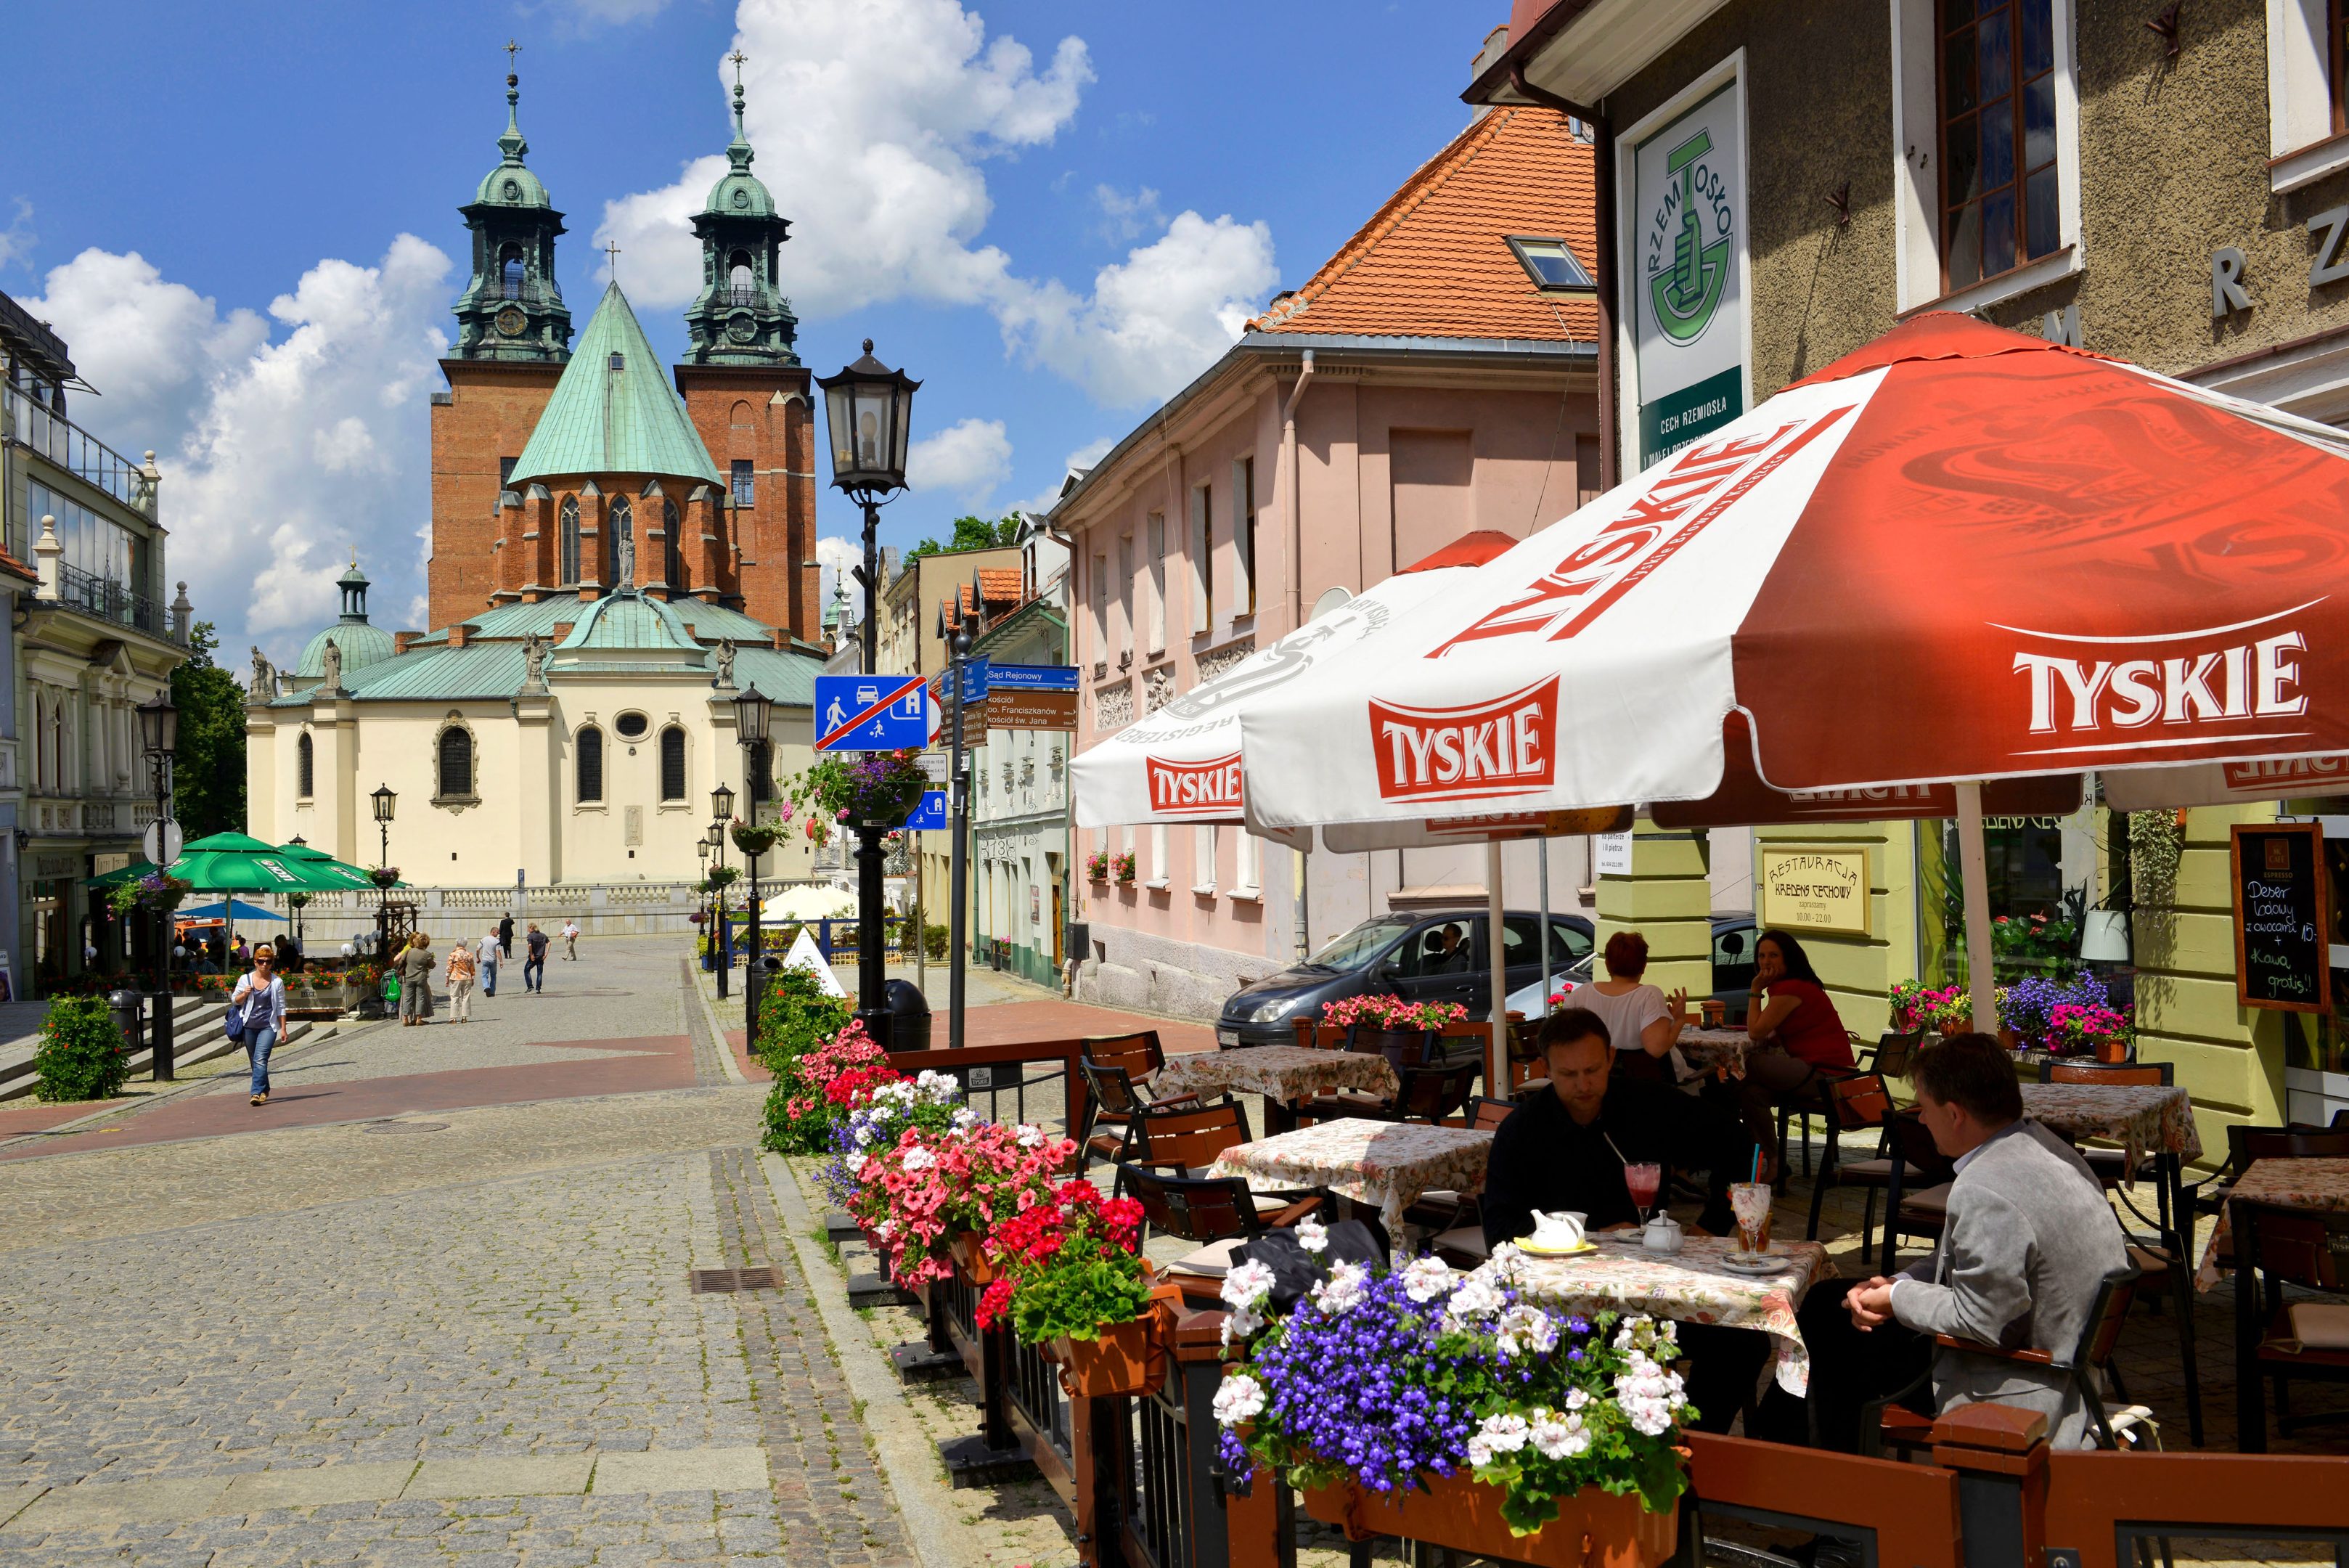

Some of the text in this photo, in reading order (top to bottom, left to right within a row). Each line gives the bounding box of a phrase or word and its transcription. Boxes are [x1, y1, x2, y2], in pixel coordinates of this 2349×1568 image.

[1660, 396, 1727, 435] CECH RZEMIOSŁA
[1423, 418, 1807, 659] TYSKIE
[1621, 547, 1674, 584] Tyskie
[1669, 499, 1733, 544] Browary
[988, 671, 1042, 681] Sąd Rejonowy
[2013, 630, 2309, 735] TYSKIE
[1002, 706, 1057, 715] Franciszkanów
[1382, 702, 1545, 788] TYSKIE
[1153, 761, 1241, 805] TYSKIE
[990, 841, 1005, 857] 13
[267, 866, 296, 881] LECH
[1776, 883, 1852, 899] KREDENS CECHOWY
[2248, 881, 2292, 899] Deser
[1799, 901, 1827, 910] zapraszamy
[1797, 912, 1811, 922] 10.00
[1815, 913, 1831, 923] 22.00
[2254, 920, 2297, 934] owocami
[2250, 947, 2291, 970] Kawa
